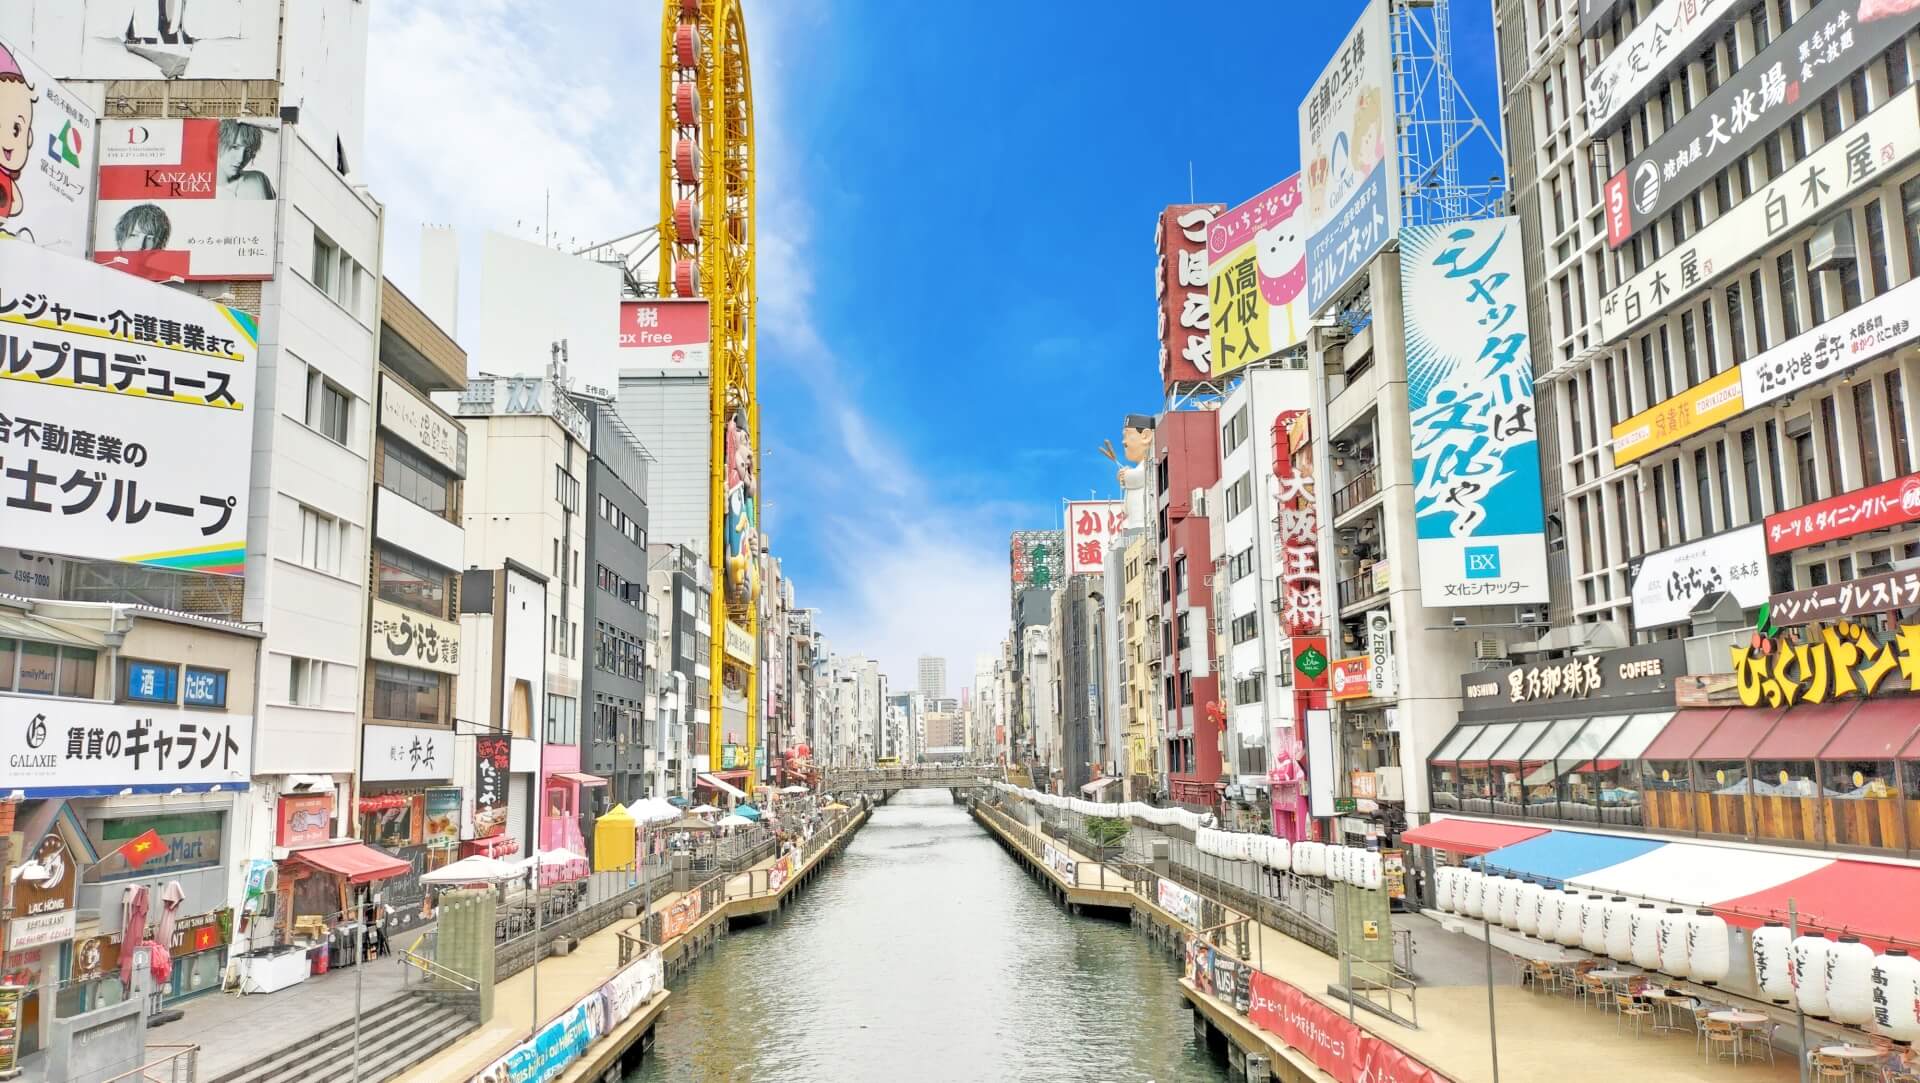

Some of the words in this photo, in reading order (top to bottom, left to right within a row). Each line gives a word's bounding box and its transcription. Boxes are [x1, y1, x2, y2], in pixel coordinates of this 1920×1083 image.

[1308, 27, 1366, 132] 店舗の王様
[1663, 136, 1703, 183] 焼肉屋
[1704, 61, 1788, 158] 大牧場
[144, 169, 213, 188] KANZAKI
[170, 182, 213, 197] RUKA
[1764, 132, 1877, 237] 白木屋
[1609, 183, 1624, 238] 5F
[1311, 203, 1386, 304] ガルフネット
[1235, 255, 1260, 360] 高収入
[1624, 248, 1702, 325] 白木屋
[618, 333, 637, 344] ax
[641, 331, 673, 344] Free
[637, 307, 659, 328] 税
[1213, 266, 1238, 368] バイト
[1759, 333, 1845, 393] たこやき王子
[0, 458, 237, 537] 士グループ
[1770, 520, 1802, 543] ダーツ
[1816, 495, 1900, 531] ダイニングバー
[1273, 468, 1324, 631] 大阪王将
[1470, 554, 1496, 570] BX
[1772, 574, 1920, 620] ハンバーグレストラ
[386, 612, 441, 664] うなぎ
[140, 669, 155, 695] 酒
[185, 675, 215, 700] たばこ
[1507, 655, 1602, 703] 星乃珈琲店
[1619, 658, 1662, 680] COFFEE
[10, 755, 57, 768] GALAXIE
[65, 718, 240, 771] 賃貸のギャラント
[409, 735, 435, 772] 歩兵
